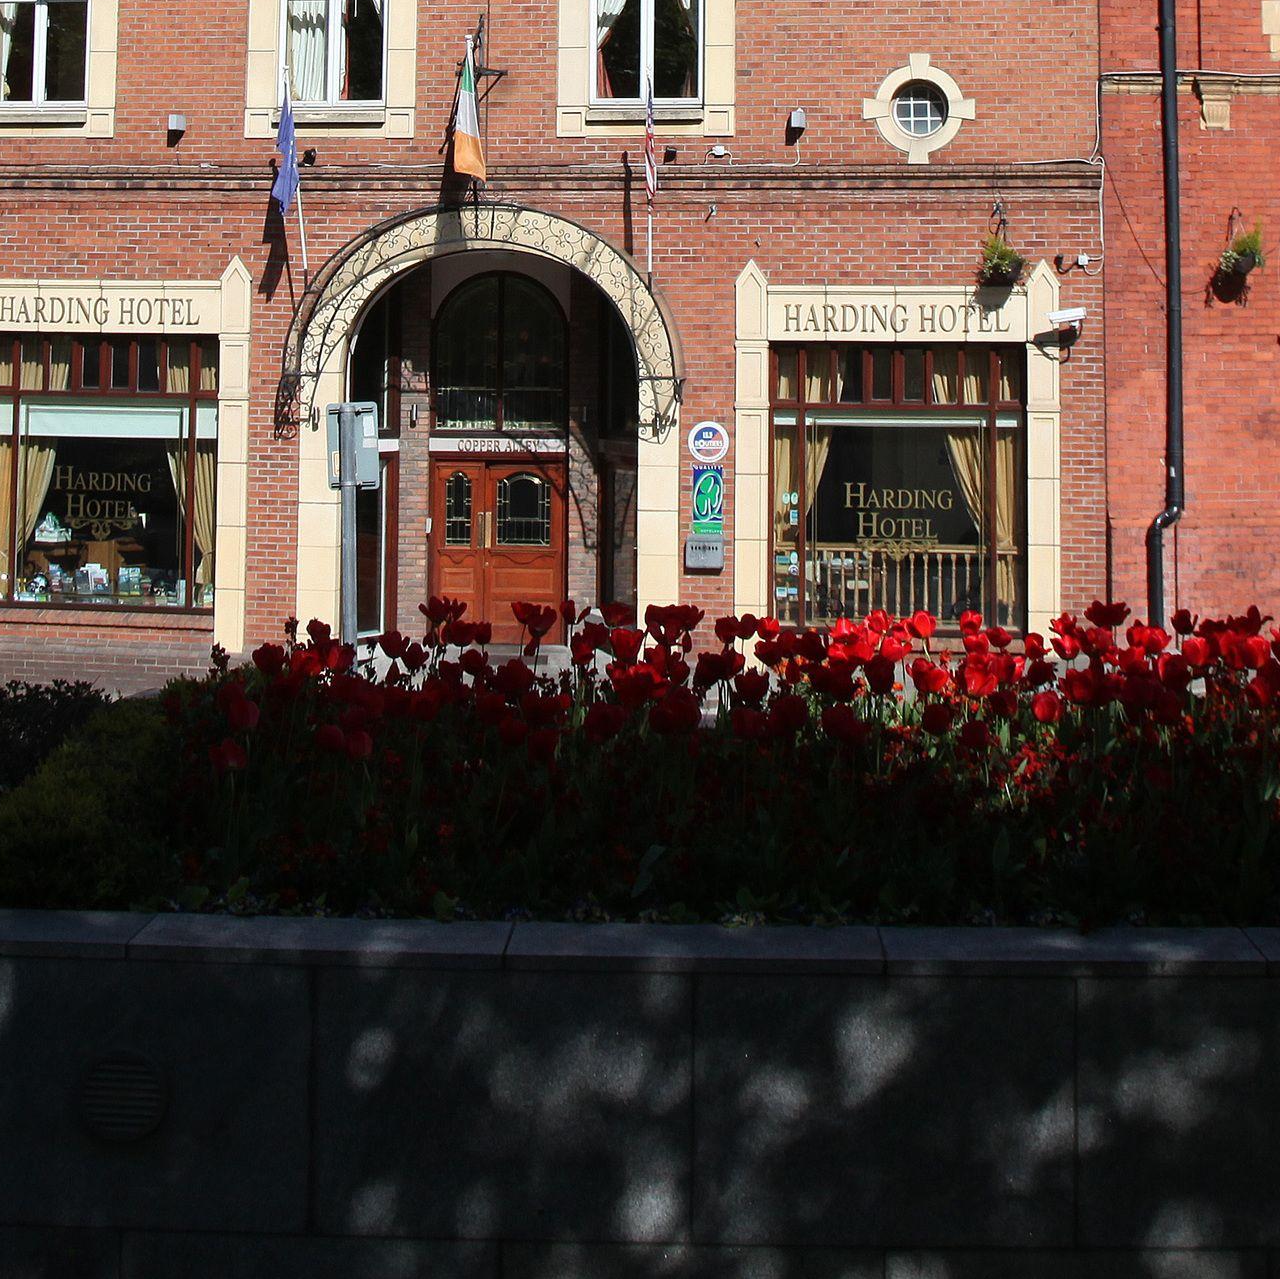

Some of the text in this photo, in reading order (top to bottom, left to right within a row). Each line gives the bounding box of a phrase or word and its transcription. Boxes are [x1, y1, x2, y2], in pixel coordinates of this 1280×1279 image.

[0, 295, 201, 326] HARDING HOTEL
[783, 303, 1011, 334] HARDING HOTEL
[457, 439, 541, 453] COPPER ALLEY
[54, 465, 151, 493] HARDING
[66, 493, 137, 518] HOTEL
[844, 482, 953, 510] HARDING
[857, 511, 937, 538] HOTEL
